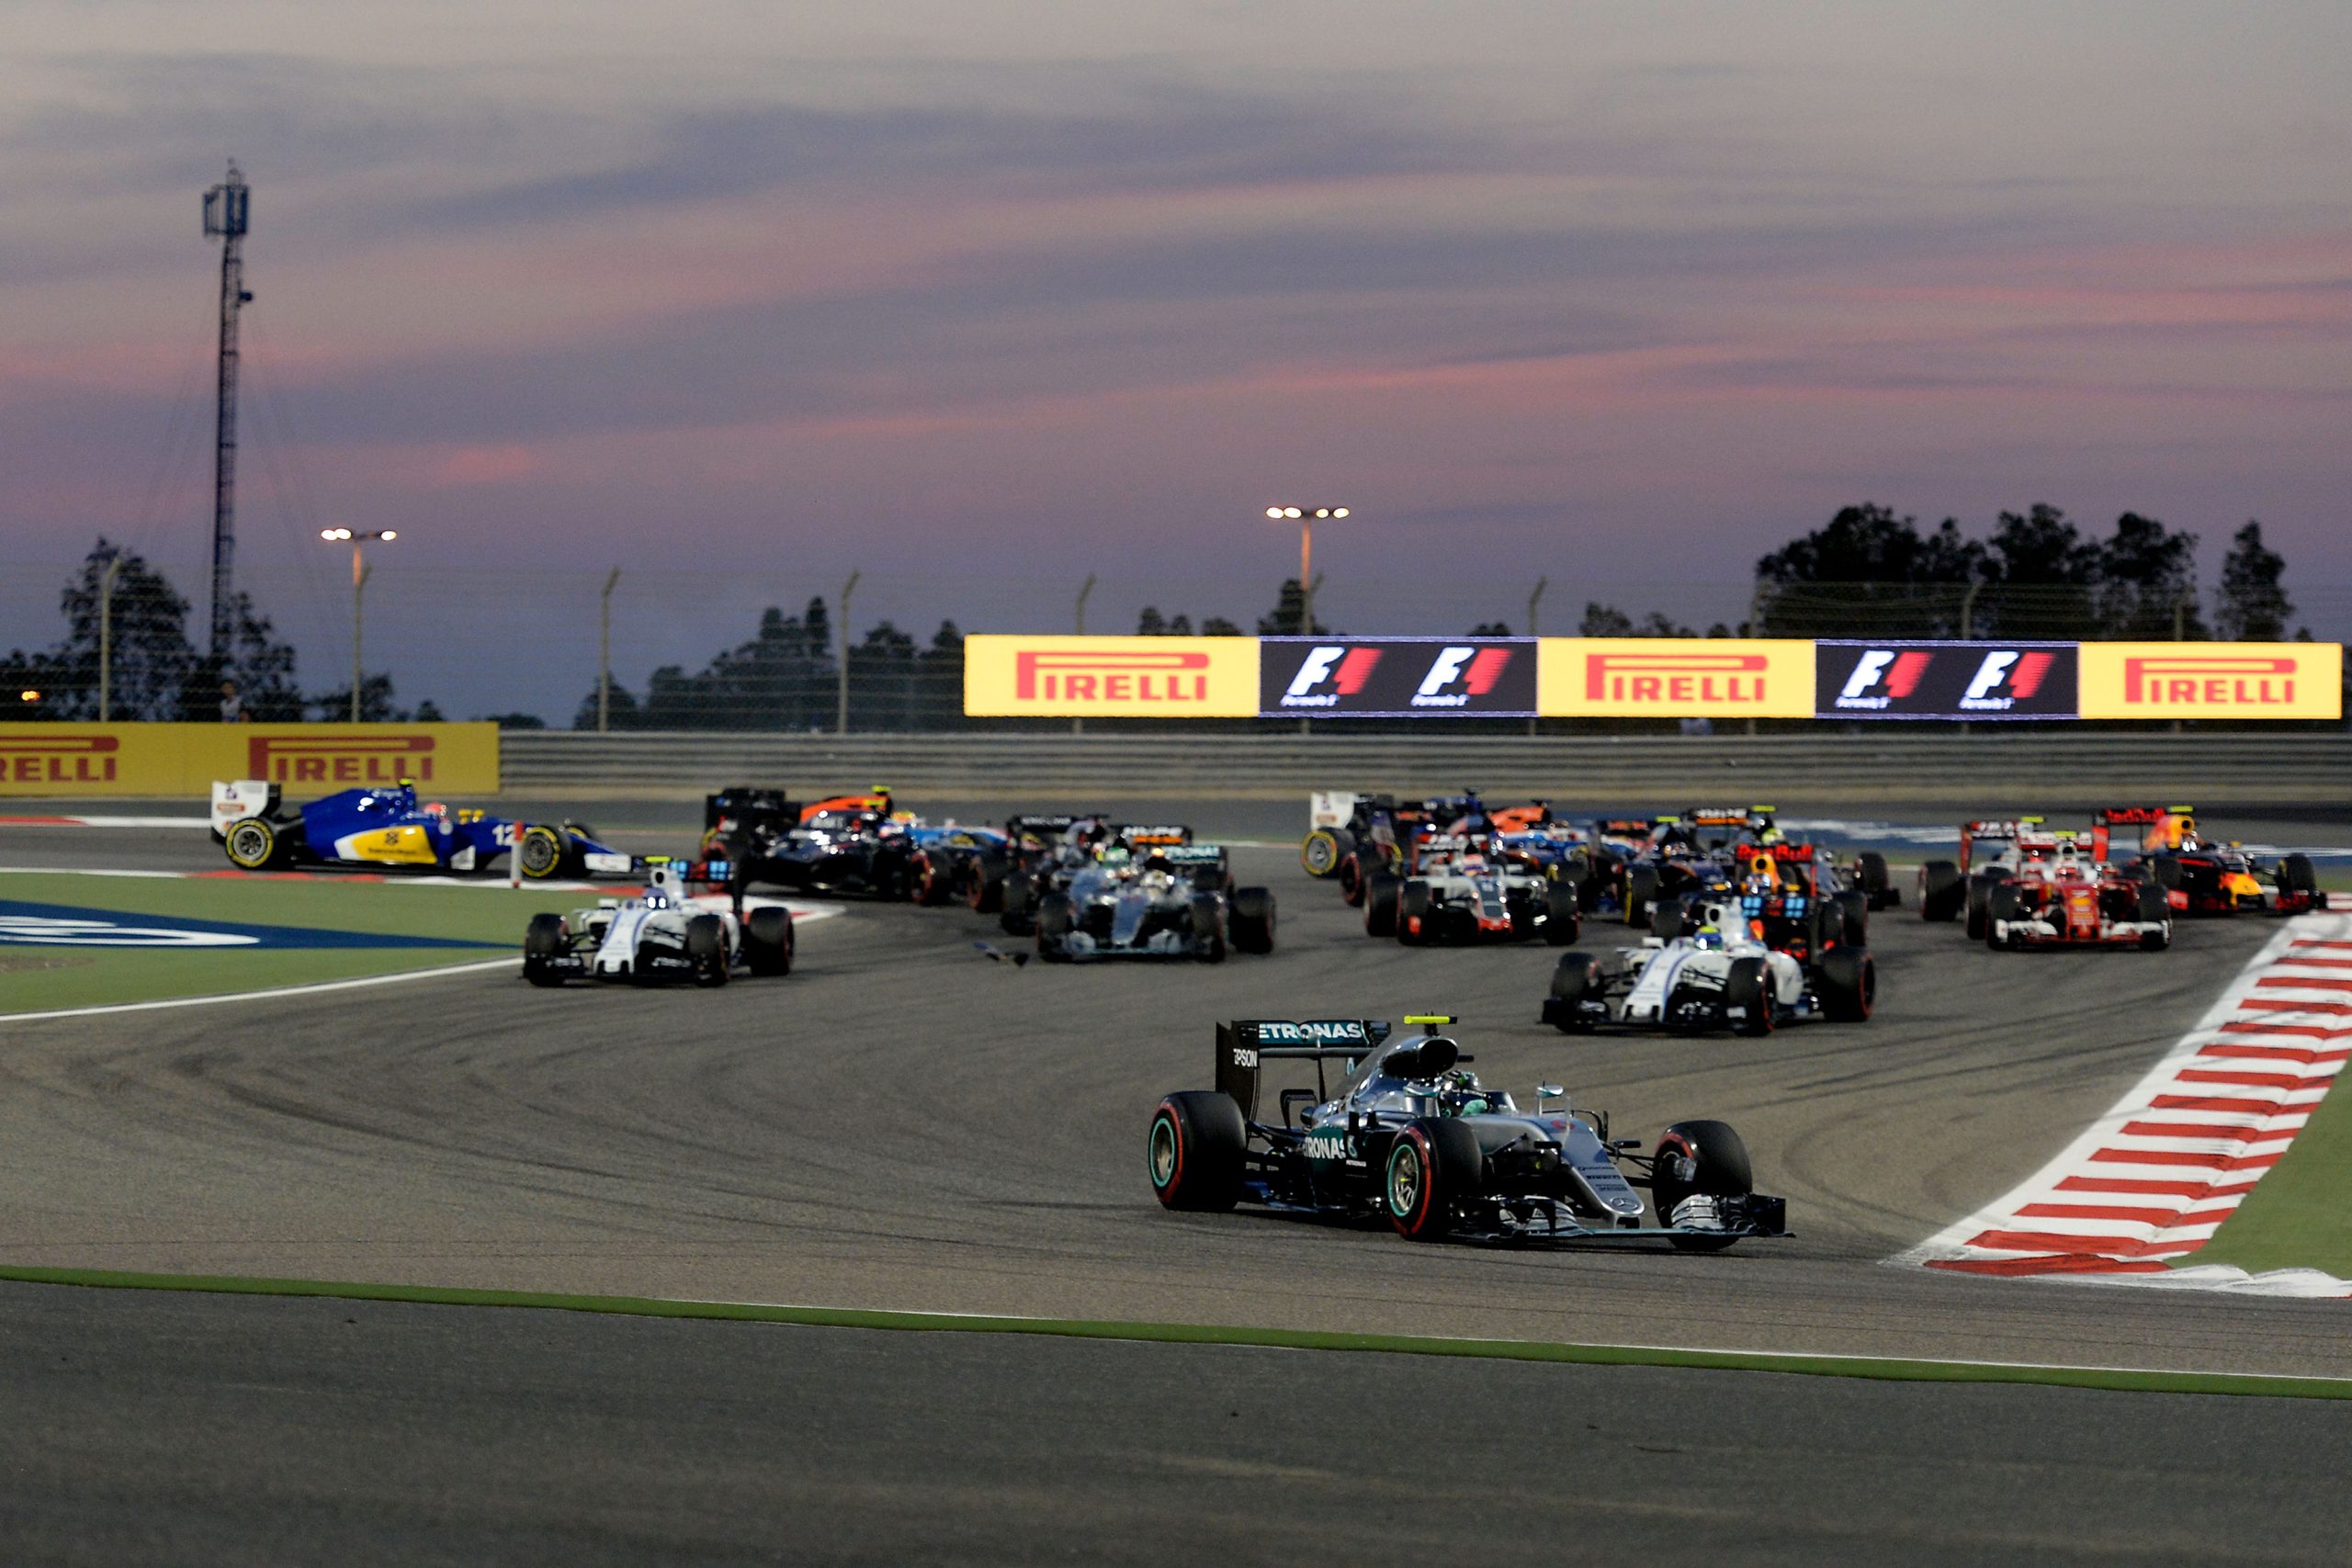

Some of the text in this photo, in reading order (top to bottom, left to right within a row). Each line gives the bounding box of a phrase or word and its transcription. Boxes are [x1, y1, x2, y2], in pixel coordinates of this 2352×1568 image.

[1016, 651, 1210, 701] PIRELLI
[1286, 646, 1385, 695] F1
[1418, 646, 1513, 695] F1
[1586, 654, 1768, 702] PIRELLI
[1841, 650, 1934, 698] F1
[1965, 650, 2057, 698] F1
[2125, 658, 2297, 704] PIRELLI
[249, 737, 435, 782] PIRELLI
[1259, 1023, 1363, 1039] ETRONAS
